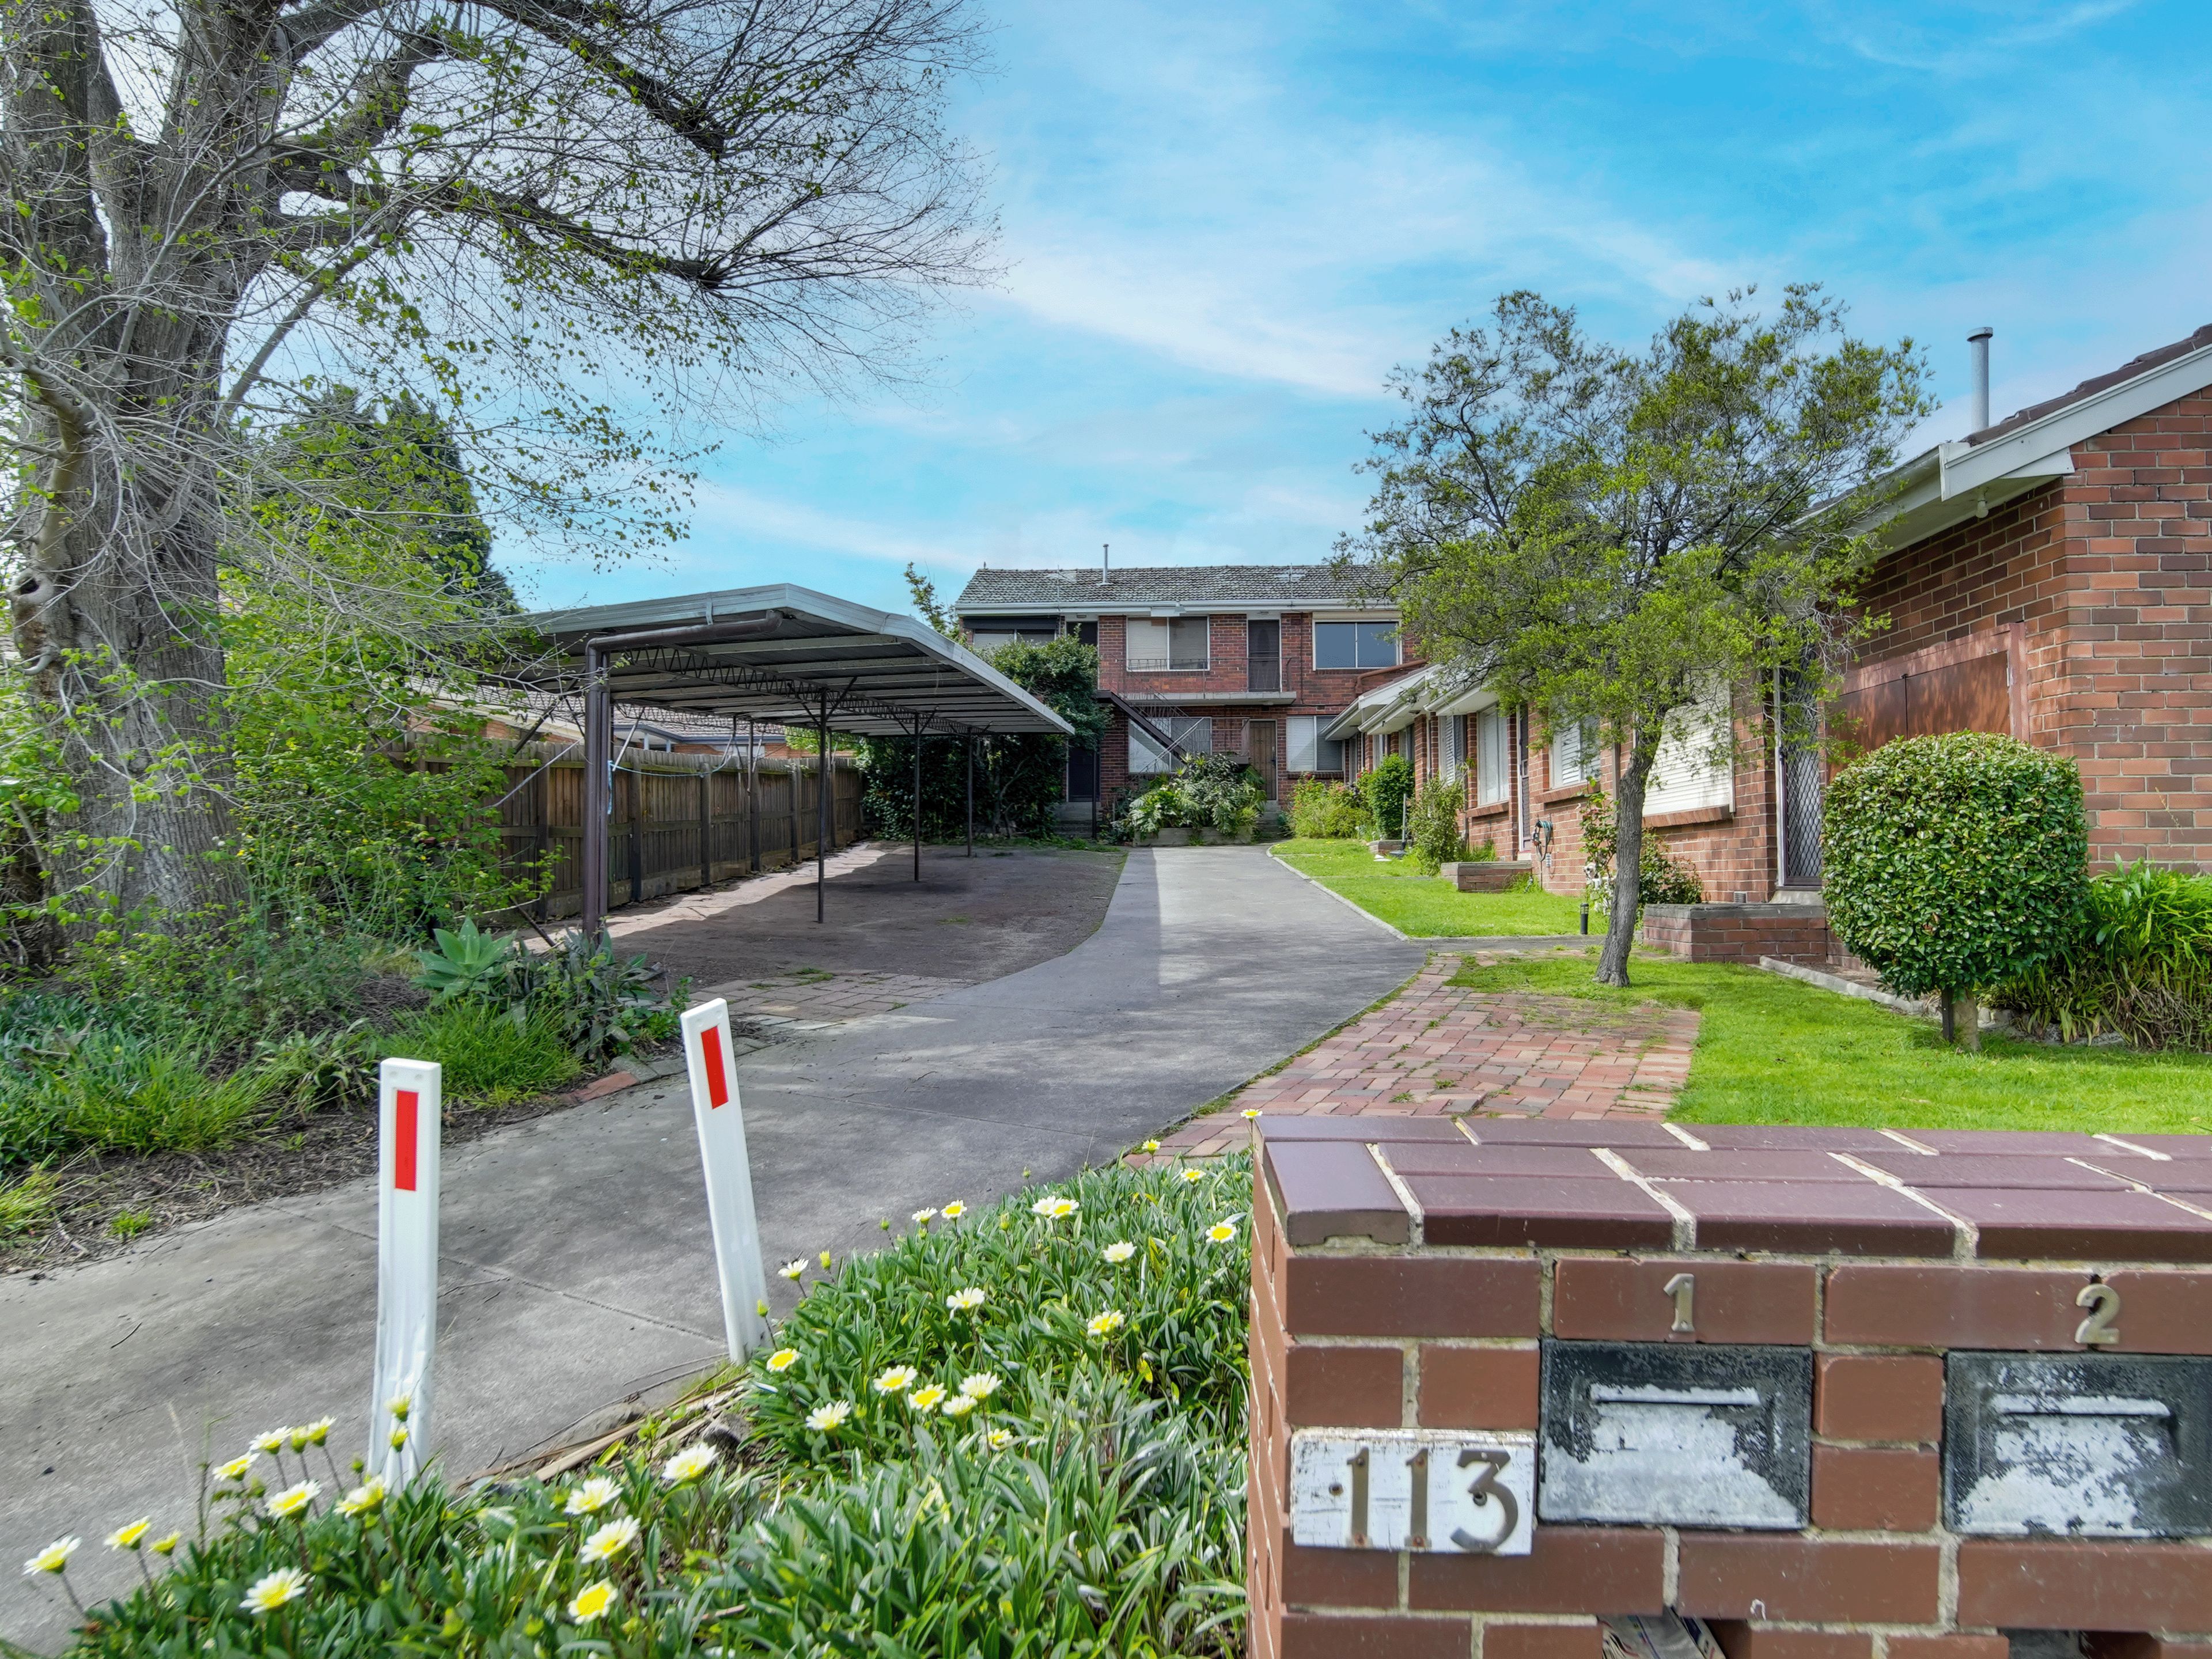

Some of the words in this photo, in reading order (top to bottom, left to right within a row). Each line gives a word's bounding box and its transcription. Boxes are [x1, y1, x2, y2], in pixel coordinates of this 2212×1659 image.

[1663, 1273, 1695, 1332] 1
[2074, 1283, 2120, 1344] 2
[1347, 1446, 1518, 1550] 113
